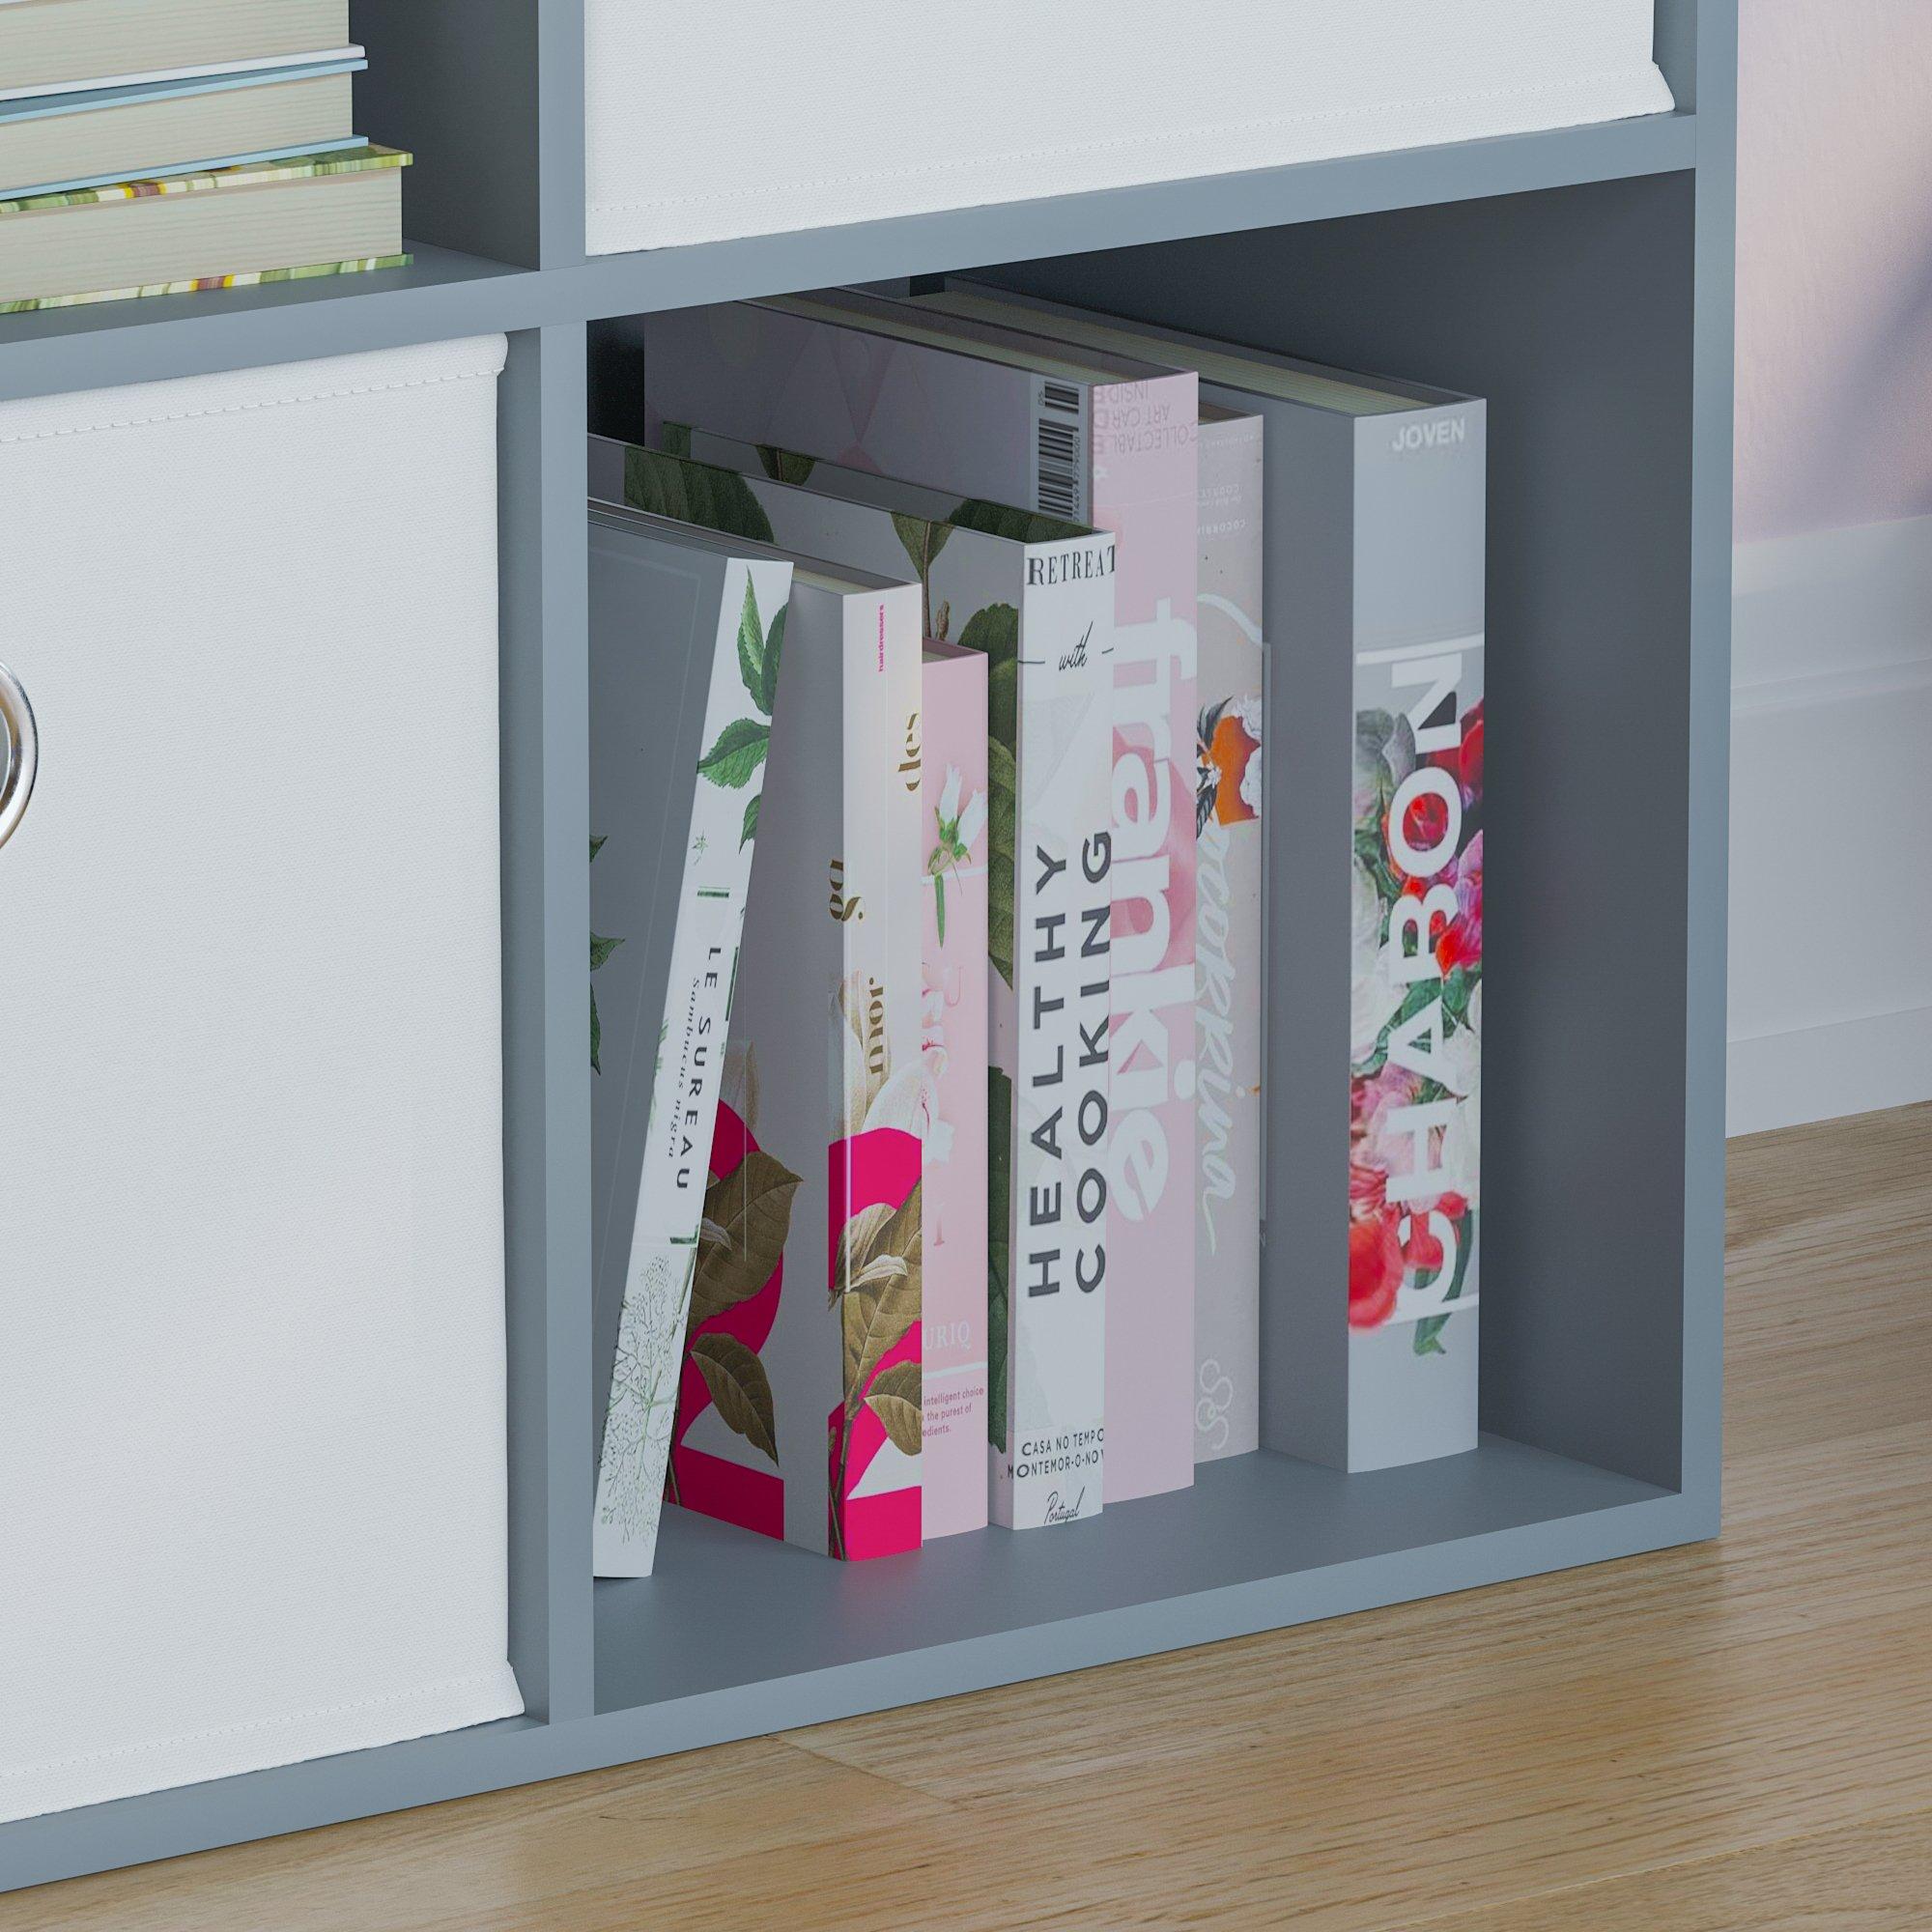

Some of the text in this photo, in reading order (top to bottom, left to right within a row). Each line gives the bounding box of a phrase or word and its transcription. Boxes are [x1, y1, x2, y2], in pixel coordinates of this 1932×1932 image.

[1148, 403, 1171, 426] ART
[1391, 415, 1465, 452] JOVEN
[1027, 544, 1115, 585] RETREAT
[1059, 620, 1094, 671] with
[898, 712, 922, 792] des
[1109, 598, 1197, 1222] frankie
[1385, 653, 1463, 1310] CHABON
[668, 977, 700, 1158] Sambucus nigra
[676, 947, 722, 1189] LE SUREAU
[1027, 844, 1067, 1299] HEALTHY
[1074, 831, 1113, 1294] COOKING
[923, 1386, 984, 1407] intelligent choice
[926, 1403, 973, 1422] the purest of
[1021, 1440, 1052, 1457] CASA
[1056, 1435, 1069, 1451] NO
[1043, 1486, 1086, 1525] Portugal
